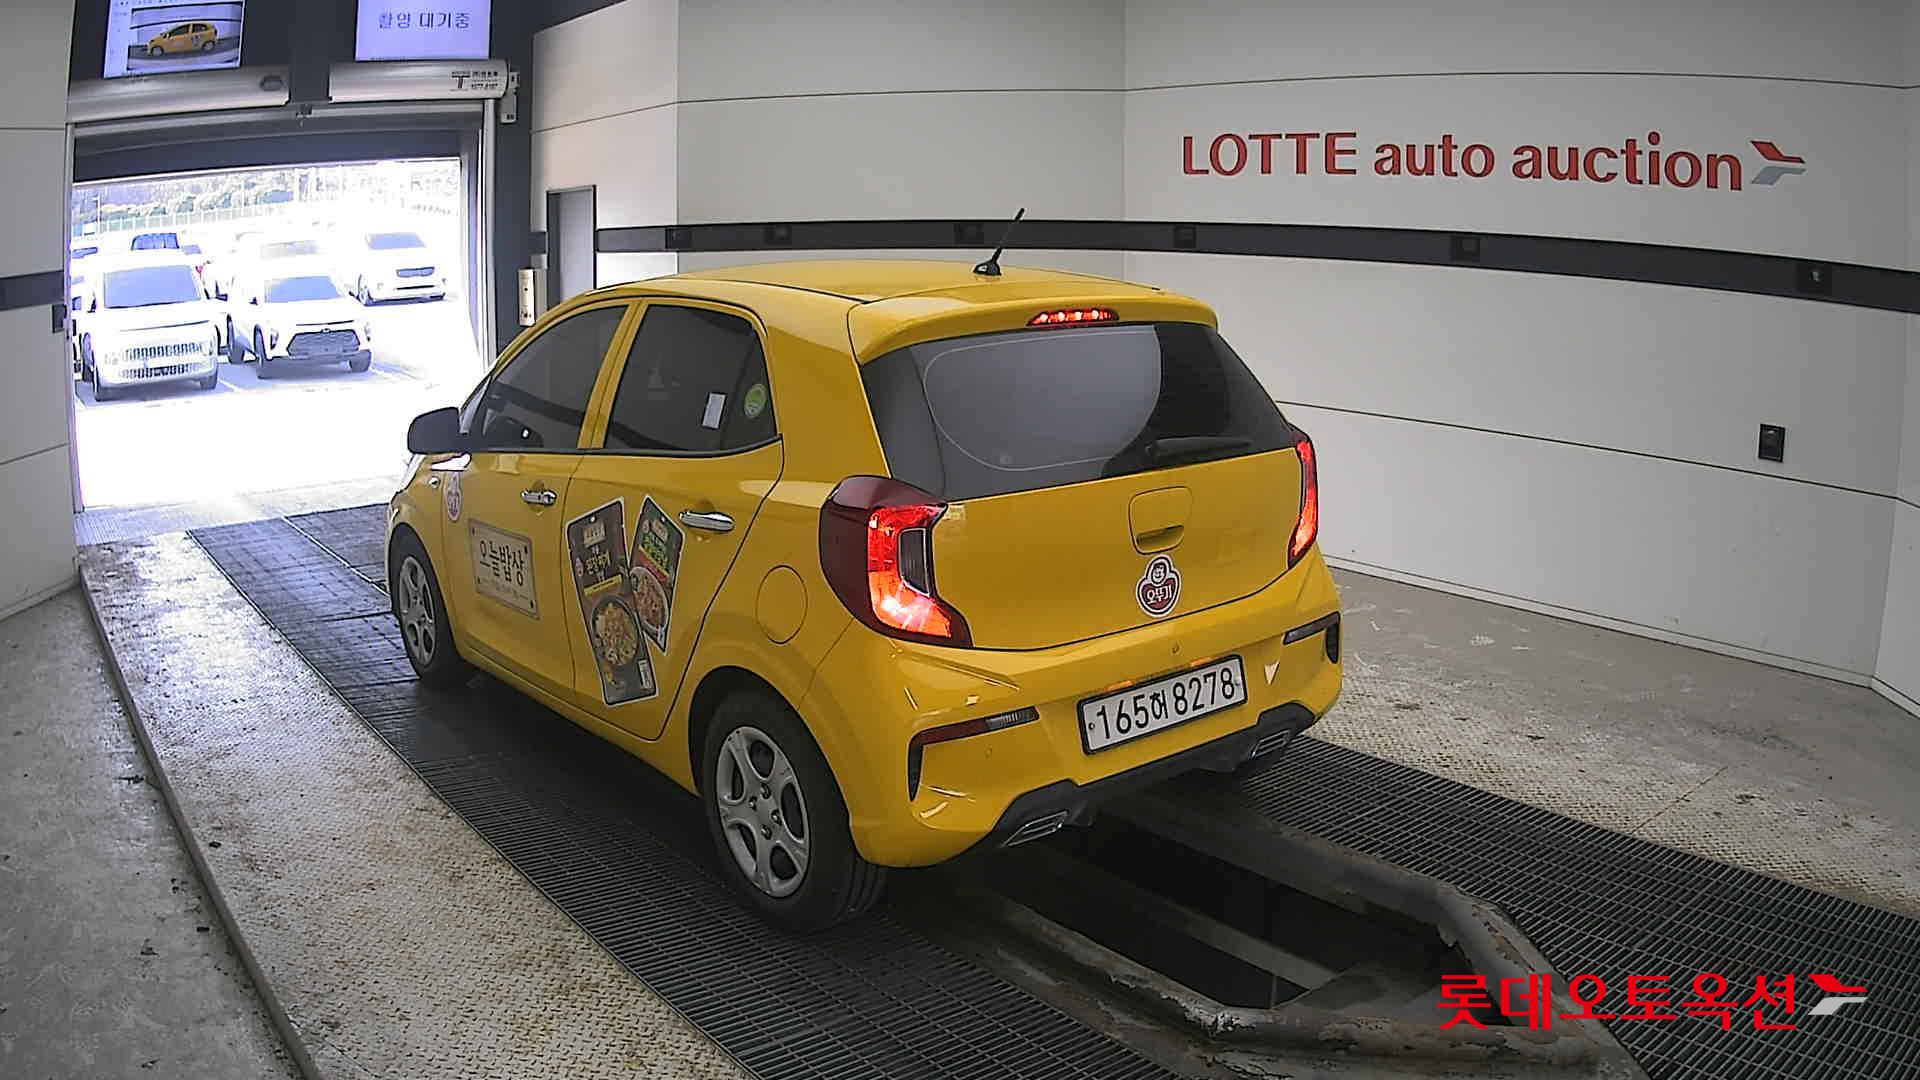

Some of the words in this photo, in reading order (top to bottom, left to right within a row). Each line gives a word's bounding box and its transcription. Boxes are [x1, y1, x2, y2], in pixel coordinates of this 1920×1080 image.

[419, 12, 470, 29] 대기중
[1183, 132, 1357, 176] LOTTE
[1374, 134, 1495, 178] auto
[1512, 131, 1742, 191] auction
[1147, 584, 1172, 604] 오뚜기
